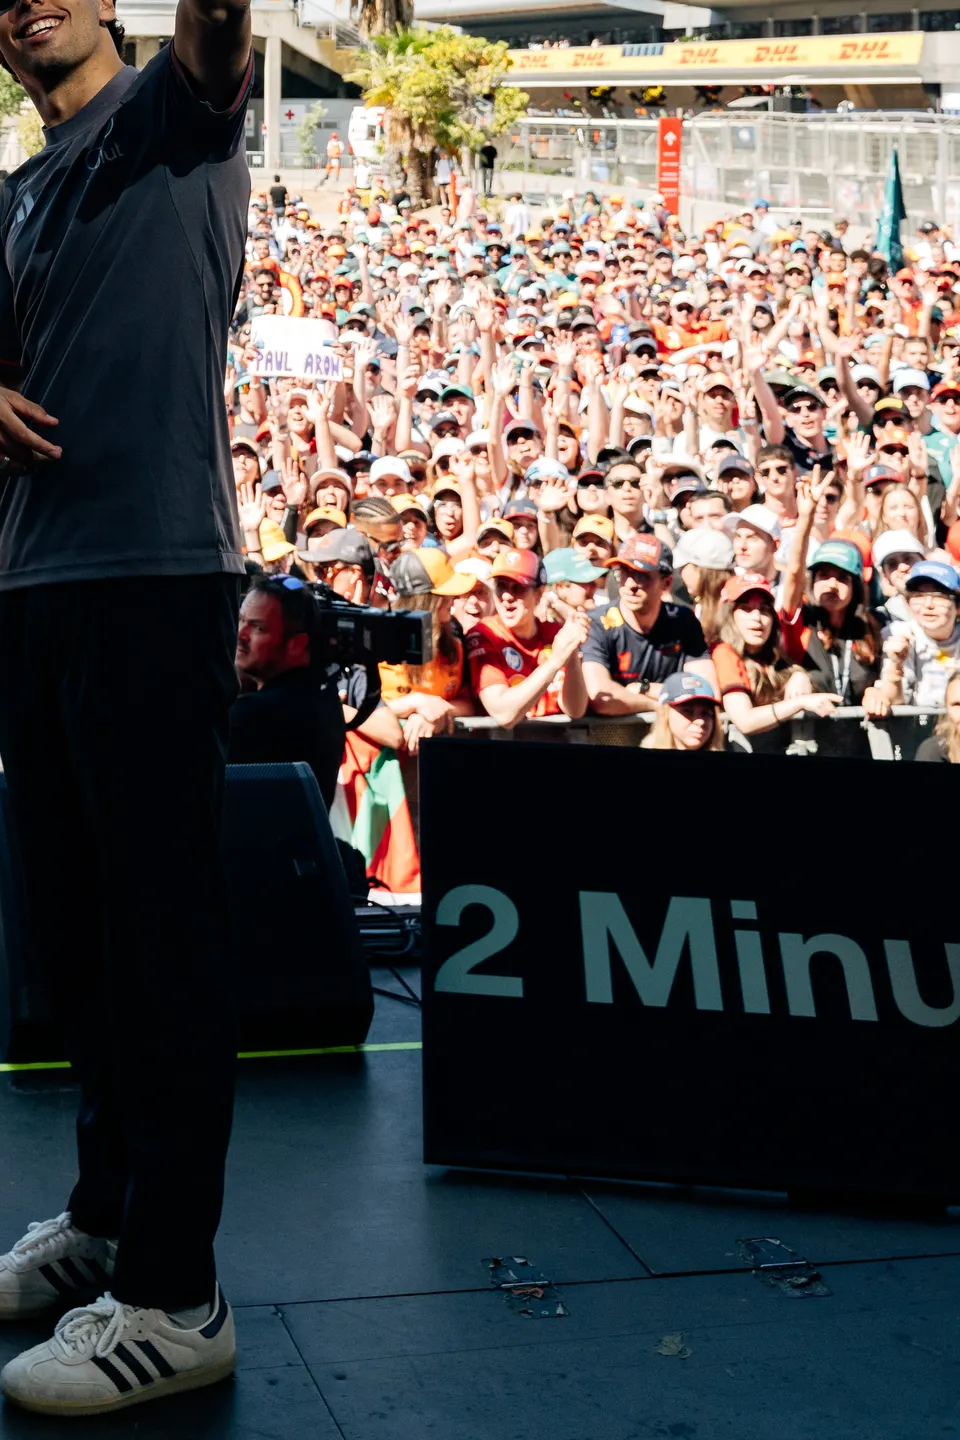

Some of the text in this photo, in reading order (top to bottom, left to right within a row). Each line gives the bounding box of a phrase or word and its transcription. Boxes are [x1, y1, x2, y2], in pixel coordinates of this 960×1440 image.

[572, 52, 604, 67] DHL
[679, 48, 718, 64] DHL
[753, 44, 798, 62] DHL
[838, 41, 889, 60] DHL
[519, 55, 547, 68] DHL
[256, 350, 292, 372] PAUL
[433, 883, 960, 1028] 2 Minu
